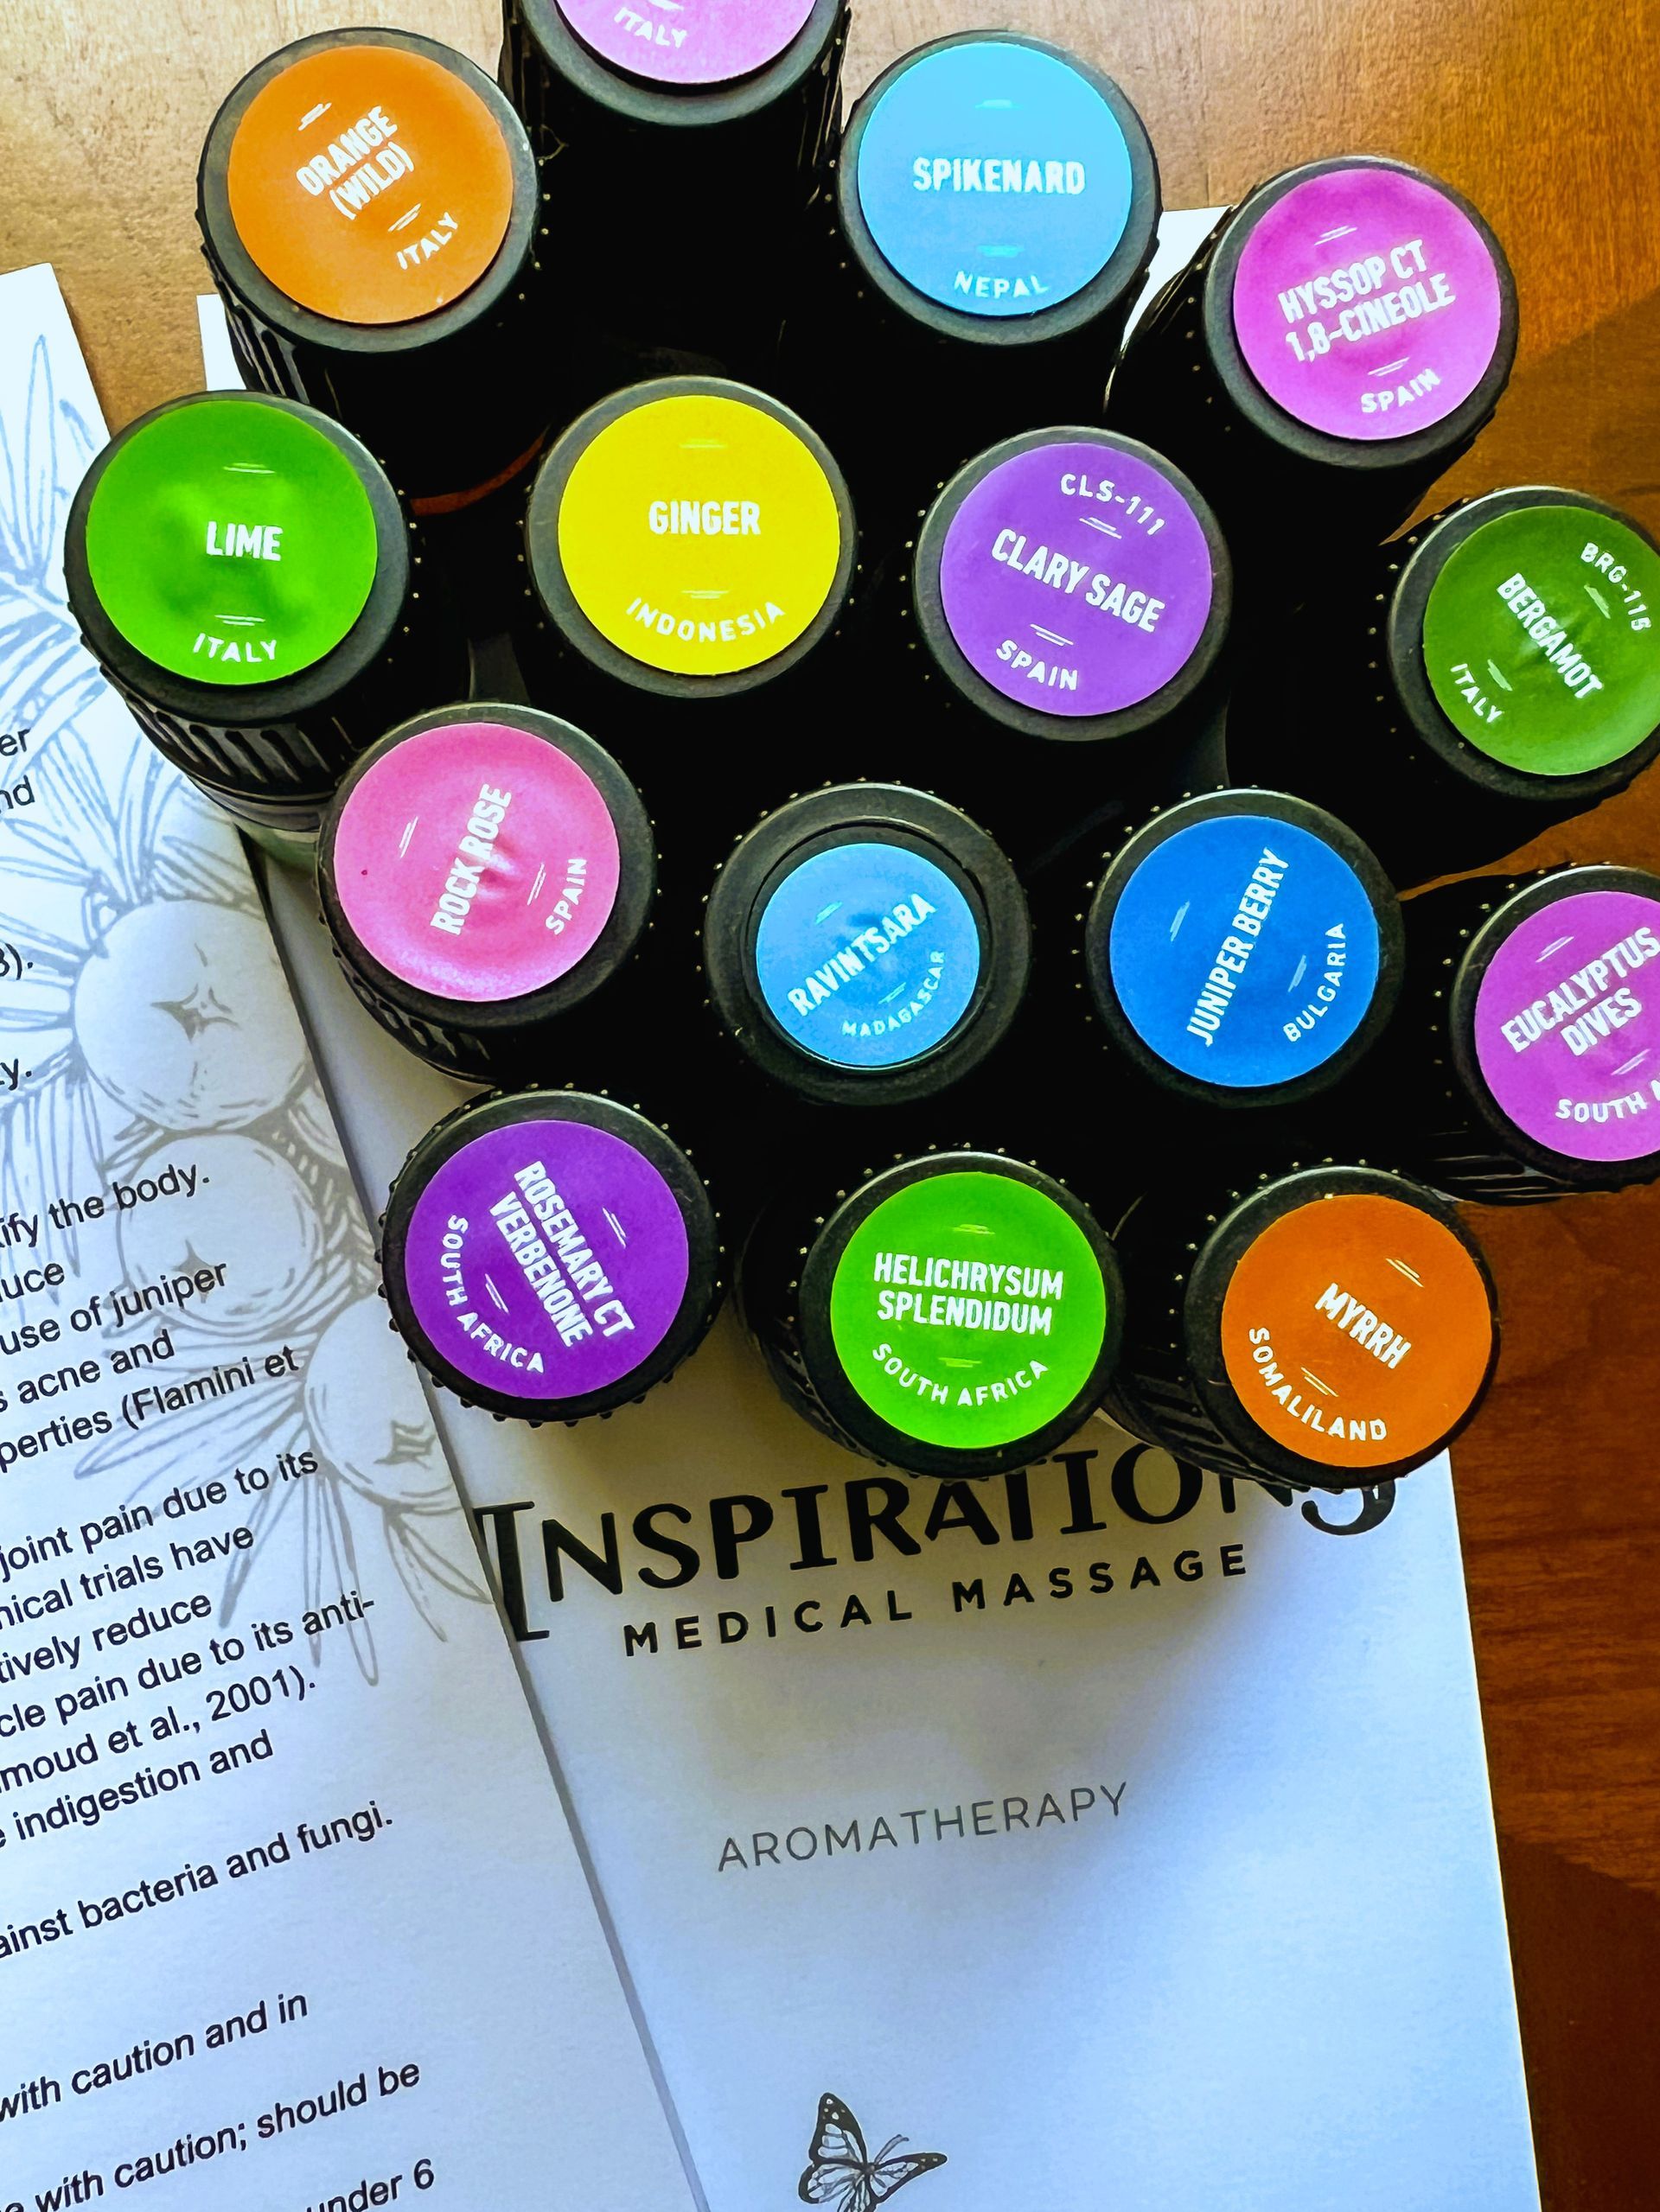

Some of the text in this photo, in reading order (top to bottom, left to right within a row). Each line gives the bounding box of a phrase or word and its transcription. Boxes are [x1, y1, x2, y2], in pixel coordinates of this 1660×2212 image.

[614, 7, 687, 48] ITALY
[297, 105, 398, 196] ORANGE
[329, 141, 414, 220] (WILD)
[913, 156, 1086, 194] SPIKENARD
[396, 212, 458, 270] ITALY
[1278, 239, 1427, 323] HYSSOP CT
[954, 270, 1050, 298] NEPAL
[1285, 272, 1456, 362] 1,8-CINEOLE
[1360, 368, 1441, 414] SPAIN
[206, 520, 284, 561] LIME
[648, 500, 762, 536] GINGER
[1060, 473, 1165, 536] CLS-111
[626, 597, 787, 643] INDONESIA
[992, 528, 1165, 634] CLARY SAGE
[192, 632, 277, 663] ITALY
[996, 640, 1078, 692] SPAIN
[1497, 572, 1605, 699] BERGAMOT
[1450, 663, 1505, 724] ITALY
[0, 728, 31, 756] er
[430, 784, 512, 935] ROCK ROSE
[546, 858, 587, 934] SPAIN
[788, 893, 937, 1017] RAVINTSARA
[1186, 846, 1289, 1048] JUNIPER BERRY
[1283, 923, 1347, 1042] BULGARIA
[841, 950, 945, 1037] MADAGASCAR
[1501, 927, 1660, 1053] EUCALYPTUS
[1561, 987, 1642, 1056] DIVES
[0, 1058, 32, 1091] y.
[1555, 1091, 1647, 1123] SOUTH
[0, 1164, 210, 1247] ify the body.
[0, 1263, 65, 1302] uce
[489, 1191, 594, 1348] VERBENONE
[514, 1160, 635, 1337] ROSEMARY CT
[873, 1252, 1063, 1300] HELICHRYSUM
[0, 1263, 227, 1355] use of juniper
[440, 1214, 544, 1374] SOUTH AFRICA
[877, 1290, 1052, 1336] SPLENDIDUM
[1315, 1282, 1412, 1369] MYRRH
[0, 1345, 299, 1474] perties (Flamini et
[17, 1360, 101, 1406] acne
[110, 1329, 175, 1374] and
[872, 1342, 1049, 1406] SOUTH AFRICA
[1248, 1327, 1388, 1441] SOMALILAND
[0, 1451, 318, 1582] joint pain due to its
[0, 1527, 253, 1629] nical trials have
[623, 1543, 1247, 1657] MEDICAL MASSAGE
[0, 1590, 375, 1737] cle pain due to its anti-
[92, 1594, 212, 1651] reduce
[0, 1665, 316, 1793] moud et al., 2001).
[13, 1729, 273, 1840] indigestion and
[718, 1782, 1127, 1872] AROMATHERAPY
[78, 1864, 218, 1928] bacteria
[227, 1833, 290, 1878] and
[297, 1801, 393, 1852] fungi.
[0, 1994, 308, 2122] with caution and in
[35, 2063, 420, 2212] with caution; should be
[413, 2158, 434, 2190] 6
